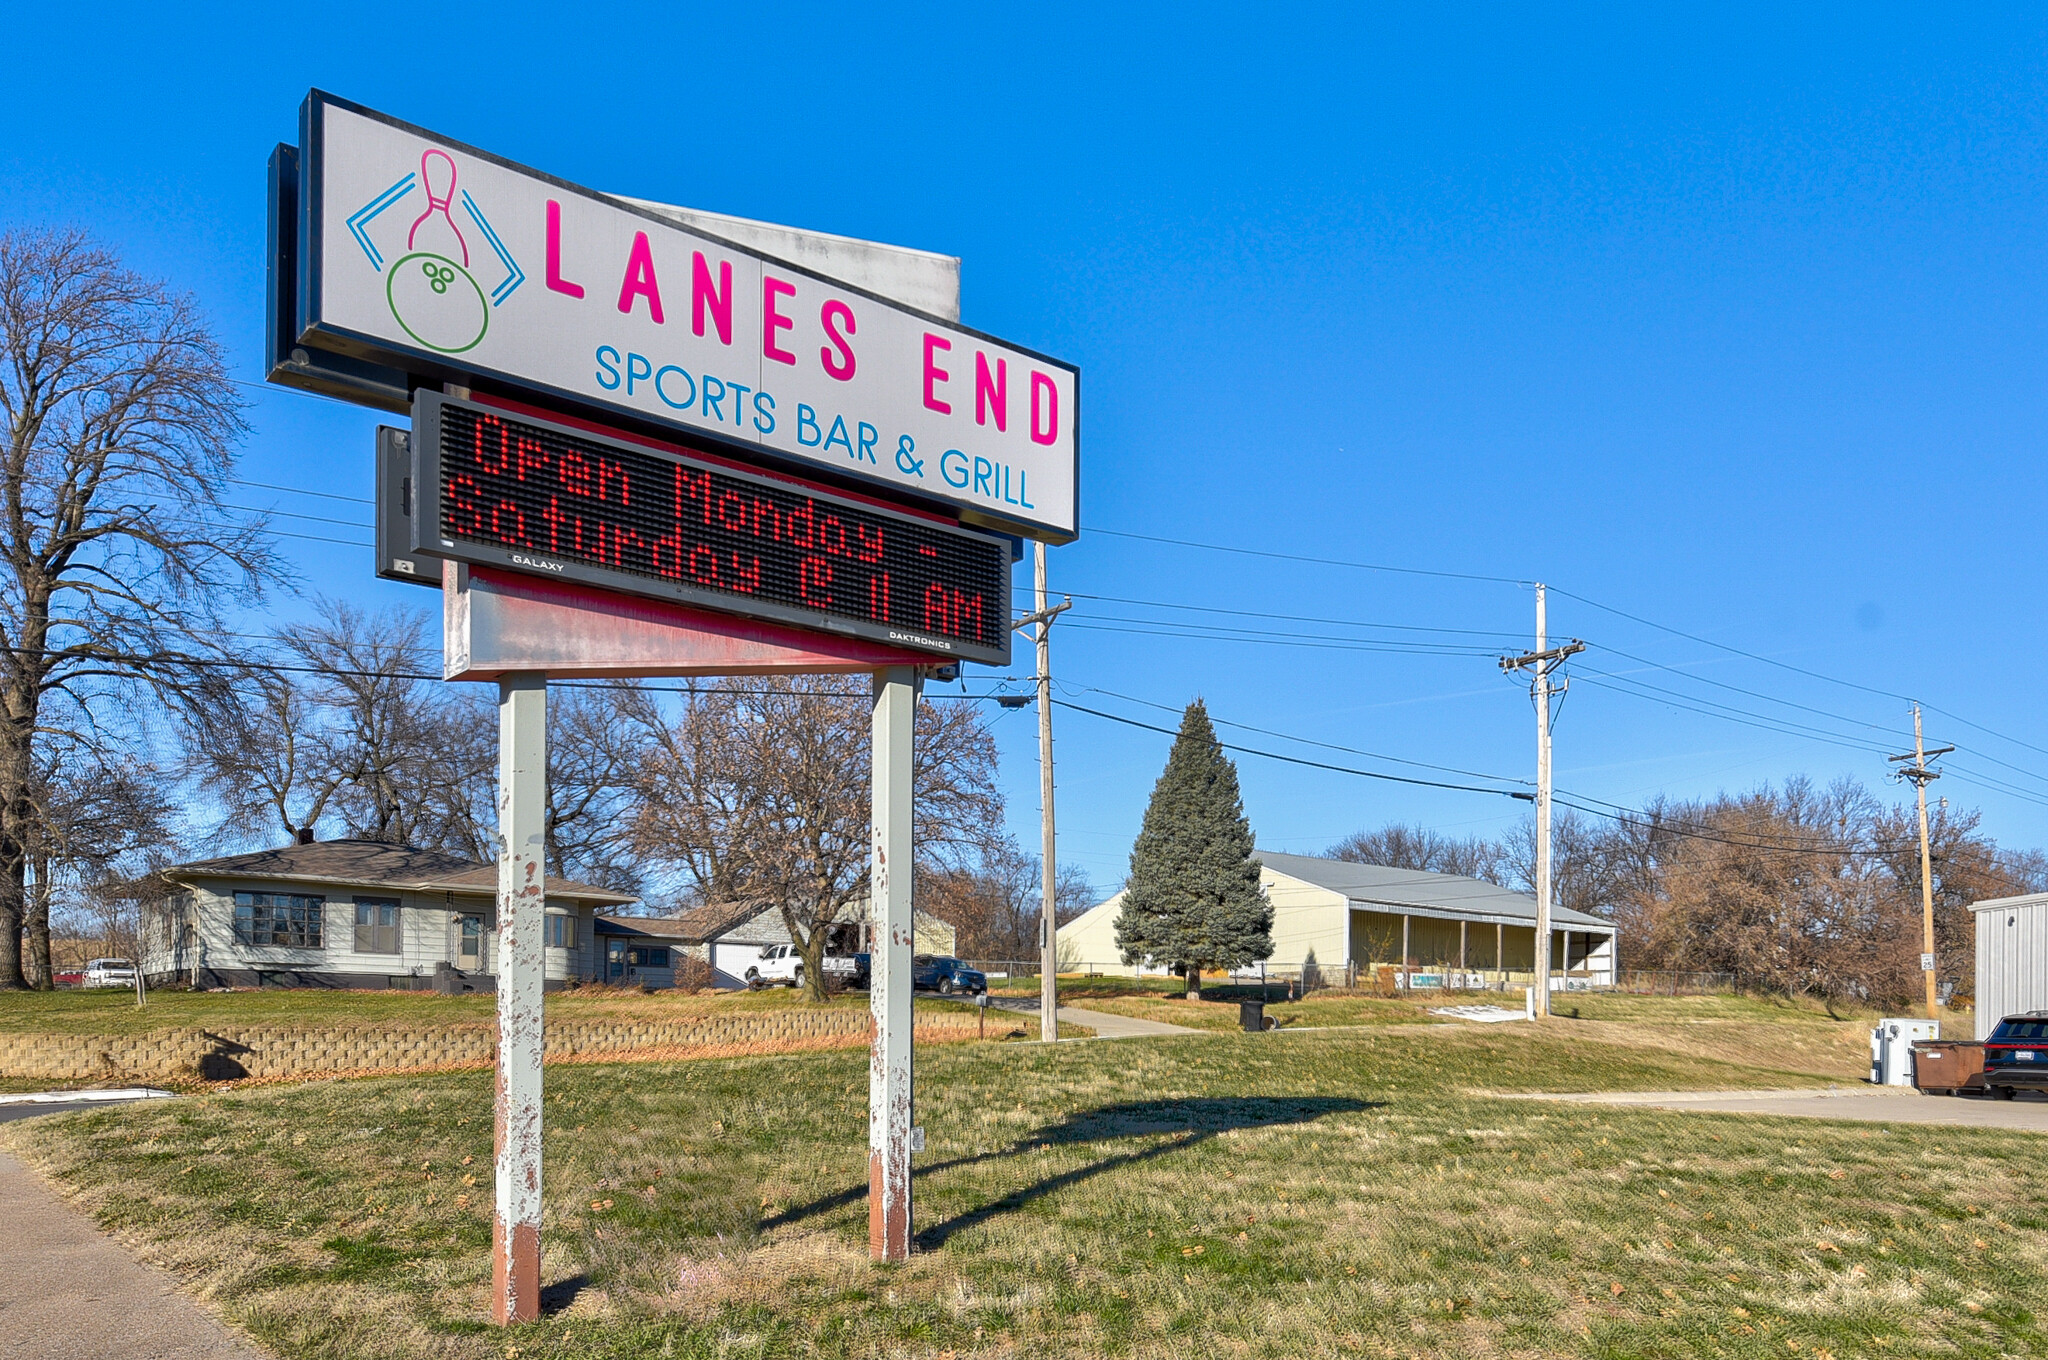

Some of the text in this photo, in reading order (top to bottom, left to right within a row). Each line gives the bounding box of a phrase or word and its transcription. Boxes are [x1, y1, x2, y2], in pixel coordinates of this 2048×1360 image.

[545, 199, 1058, 446] LANES END
[475, 412, 630, 506] Open
[675, 462, 884, 564] Monday
[596, 345, 1035, 510] SPORTS BAR & GRILL
[448, 472, 761, 594] Saturday
[870, 571, 890, 622] 11
[924, 581, 983, 641] AM
[512, 554, 565, 572] GALAXY
[889, 631, 951, 650] DAKTRONICS
[1923, 961, 1932, 969] 25
